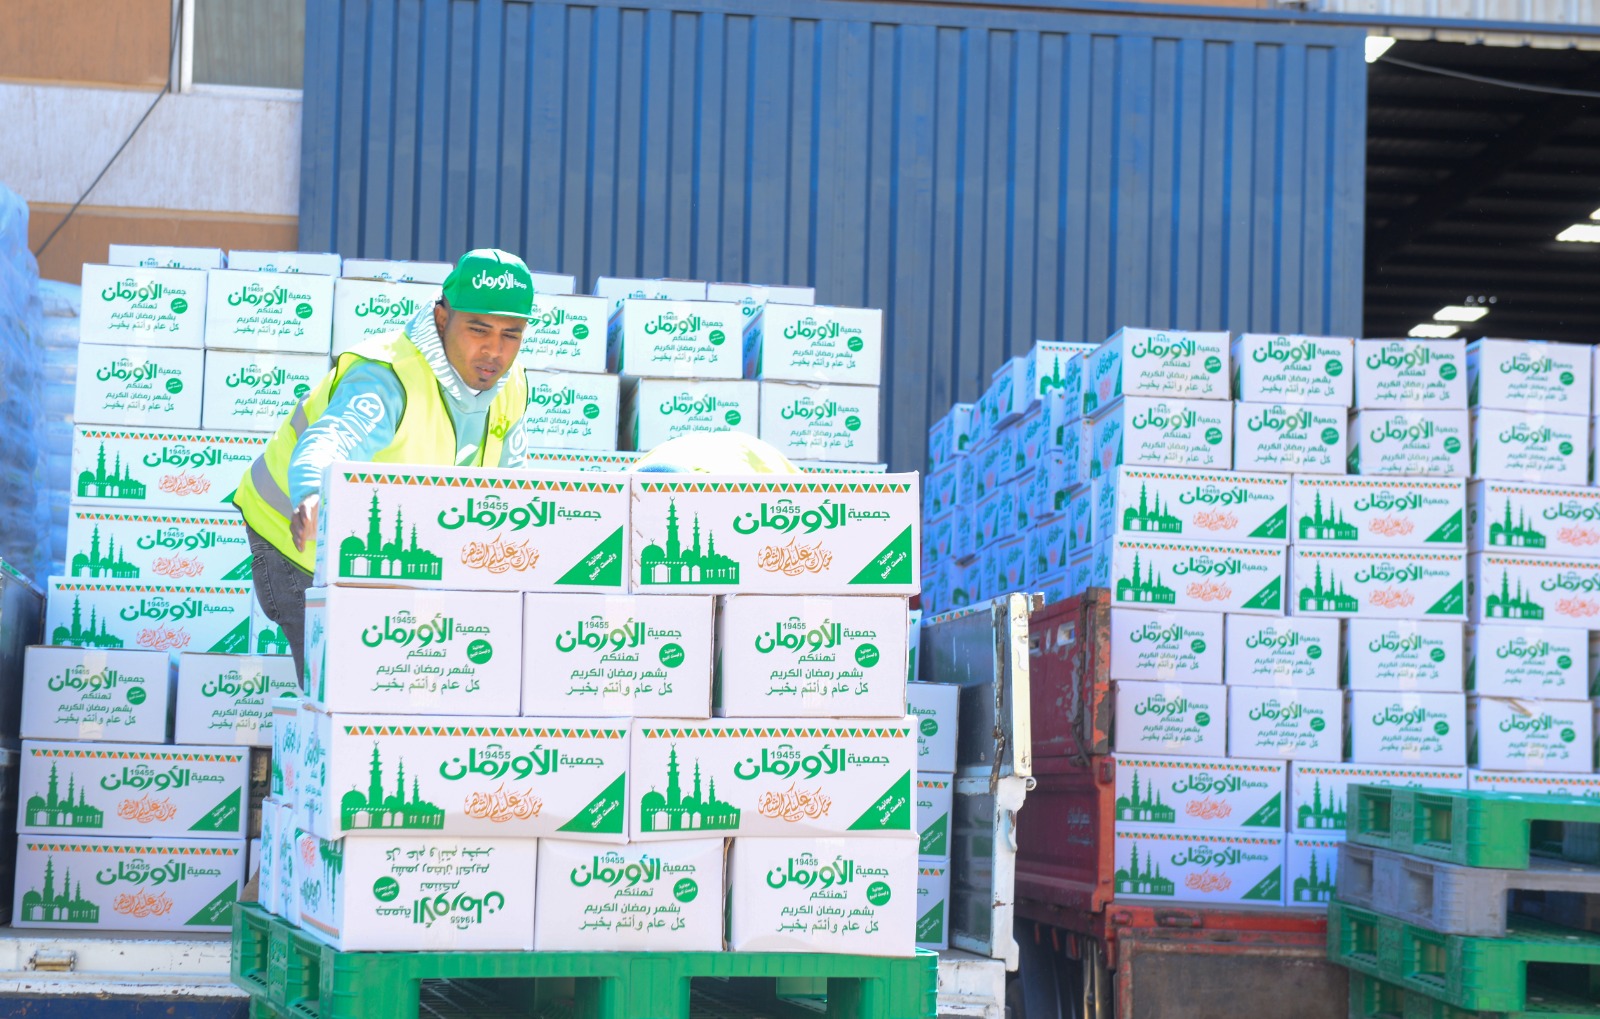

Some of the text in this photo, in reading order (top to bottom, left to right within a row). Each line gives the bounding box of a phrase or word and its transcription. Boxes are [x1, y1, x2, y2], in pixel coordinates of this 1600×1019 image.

[101, 279, 186, 304] جمعية الأورمان
[644, 313, 723, 336] جمعية الأورمان
[783, 318, 862, 342] جمعية الأورمان
[781, 398, 859, 421] جمعية الأورمان
[437, 494, 602, 531] جمعية الأورمان
[476, 501, 508, 510] 19455
[770, 506, 800, 514] 19455
[733, 499, 890, 534] جمعية الأورمان
[120, 596, 234, 622] جمعية الأورمان
[361, 612, 490, 649] جمعية الأورمان
[555, 617, 682, 653] جمعية الأورمان
[755, 618, 876, 654] جمعية الأورمان
[406, 649, 446, 660] تهنئكم
[600, 653, 639, 664] تهنئكم
[798, 654, 835, 664] تهنئكم
[376, 664, 475, 677] بشهر رمضان الكريم
[570, 668, 667, 680] بشهر رمضان الكريم
[770, 668, 863, 680] بشهر رمضان الكريم
[48, 666, 145, 694] جمعية الأورمان
[441, 680, 460, 694] عام
[465, 679, 480, 693] كل
[634, 684, 653, 698] عام
[658, 682, 672, 696] كل
[832, 684, 849, 698] عام
[855, 682, 868, 695] كل
[440, 744, 604, 780] جمعية الأورمان
[479, 751, 511, 759] 19455
[734, 744, 890, 780] جمعية الأورمان
[770, 751, 800, 759] 19455
[100, 764, 225, 792] جمعية الأورمان
[96, 858, 221, 886] جمعية الأورمان
[570, 852, 697, 888] جمعية الأورمان
[766, 854, 889, 891] جمعية الأورمان
[614, 888, 653, 899] تهنئكم
[809, 890, 847, 901] تهنئكم
[376, 891, 505, 928] جمعية الأورمان
[584, 902, 681, 915] بشهر رمضان الكريم
[781, 905, 874, 918] بشهر رمضان الكريم
[647, 919, 666, 932] عام
[671, 917, 685, 930] كل
[842, 922, 860, 935] عام
[865, 920, 879, 934] كل
